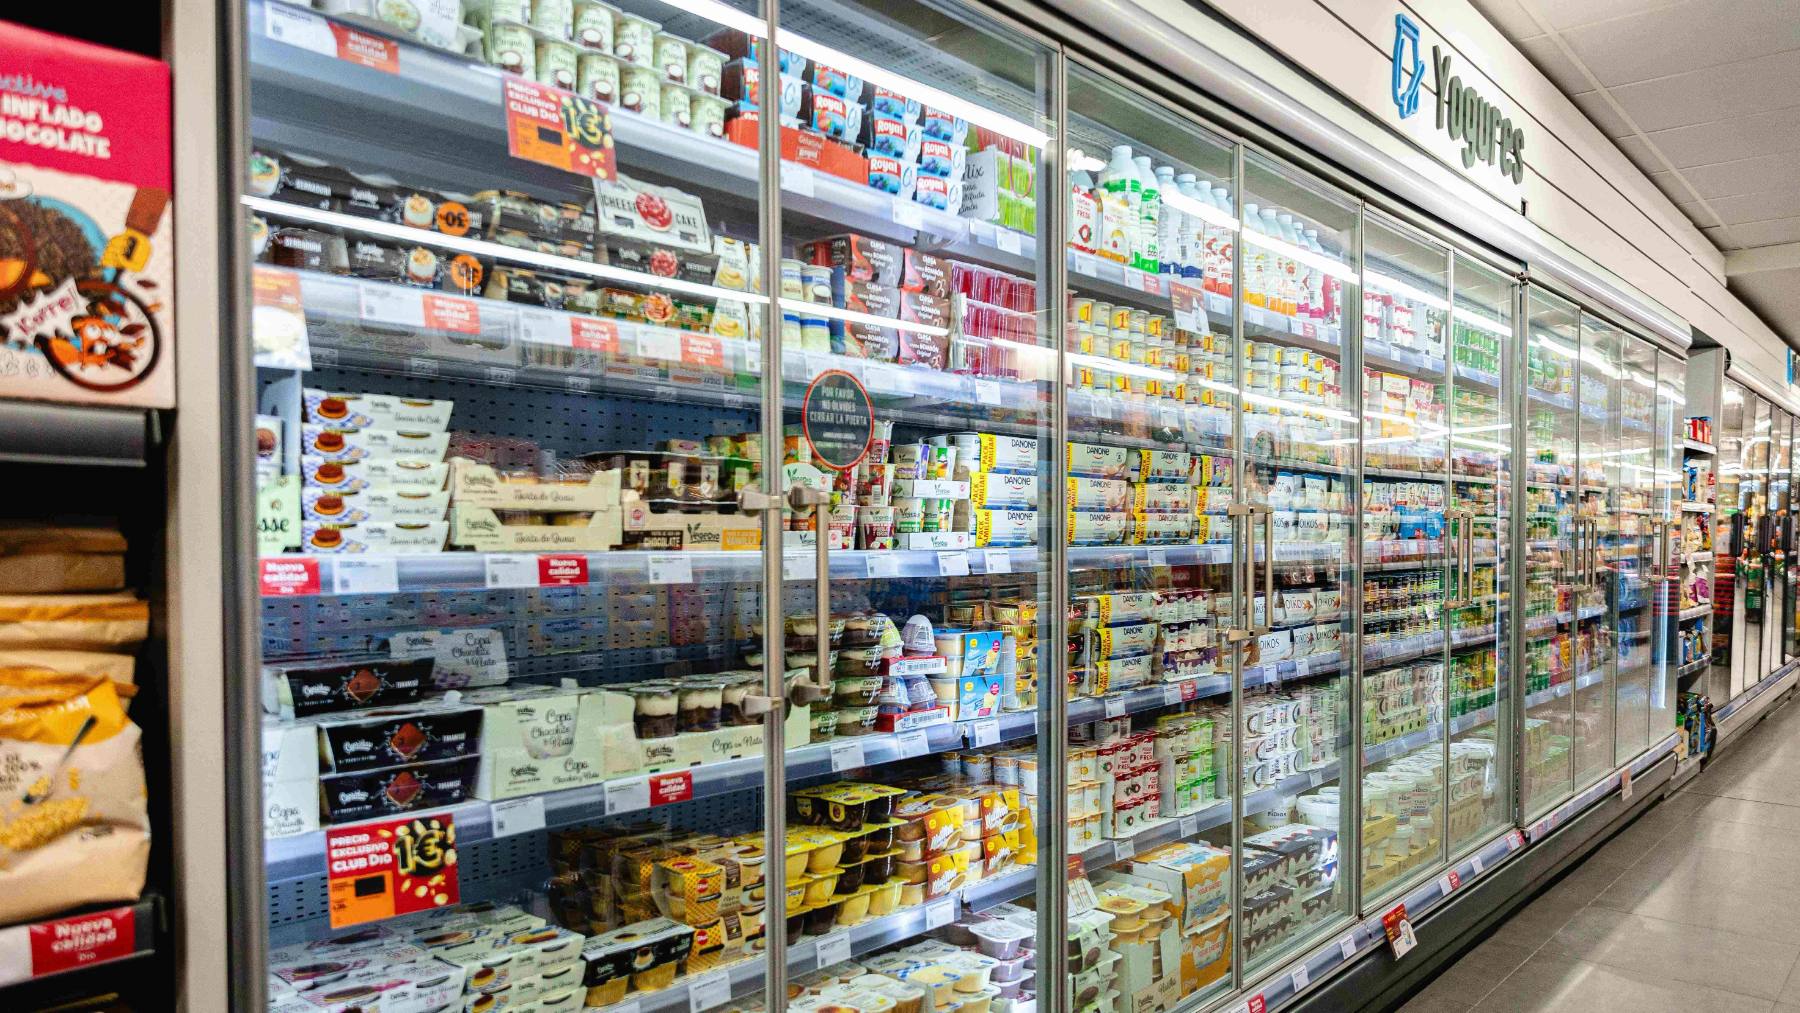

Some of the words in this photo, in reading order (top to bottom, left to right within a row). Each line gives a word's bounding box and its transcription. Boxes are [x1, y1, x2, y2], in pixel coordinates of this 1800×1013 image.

[815, 93, 845, 113] Royal
[2, 92, 104, 134] INFLADO
[509, 101, 539, 118] CLUB
[539, 108, 560, 124] Dia
[1432, 45, 1524, 185] Yogures
[877, 120, 904, 137] Royal
[923, 141, 950, 157] Royal
[869, 157, 899, 174] Royal
[917, 177, 946, 192] Royal
[676, 213, 699, 228] CAKE
[1011, 439, 1037, 450] DANONE
[1086, 446, 1110, 456] DANONE
[1004, 475, 1031, 486] DANONE
[1007, 511, 1033, 521] DANONE
[1089, 513, 1111, 522] DANONE
[1299, 519, 1319, 529] OIKOS
[549, 559, 578, 567] Nueva
[548, 567, 581, 576] calidad
[1122, 595, 1143, 603] DANONE
[1123, 627, 1143, 635] DANONE
[1260, 637, 1281, 650] OIKOS
[1121, 657, 1142, 667] DANONE
[545, 708, 572, 726] Copa
[711, 738, 733, 754] Copa
[563, 758, 589, 774] Copa
[659, 783, 686, 795] calidad
[660, 777, 684, 786] Nueva
[330, 834, 370, 847] PRECIO
[331, 842, 390, 858] EXCLUSIVO
[331, 858, 368, 872] CLUB
[367, 853, 393, 866] Dia
[54, 917, 114, 939] Nueva
[51, 927, 117, 953] calidad
